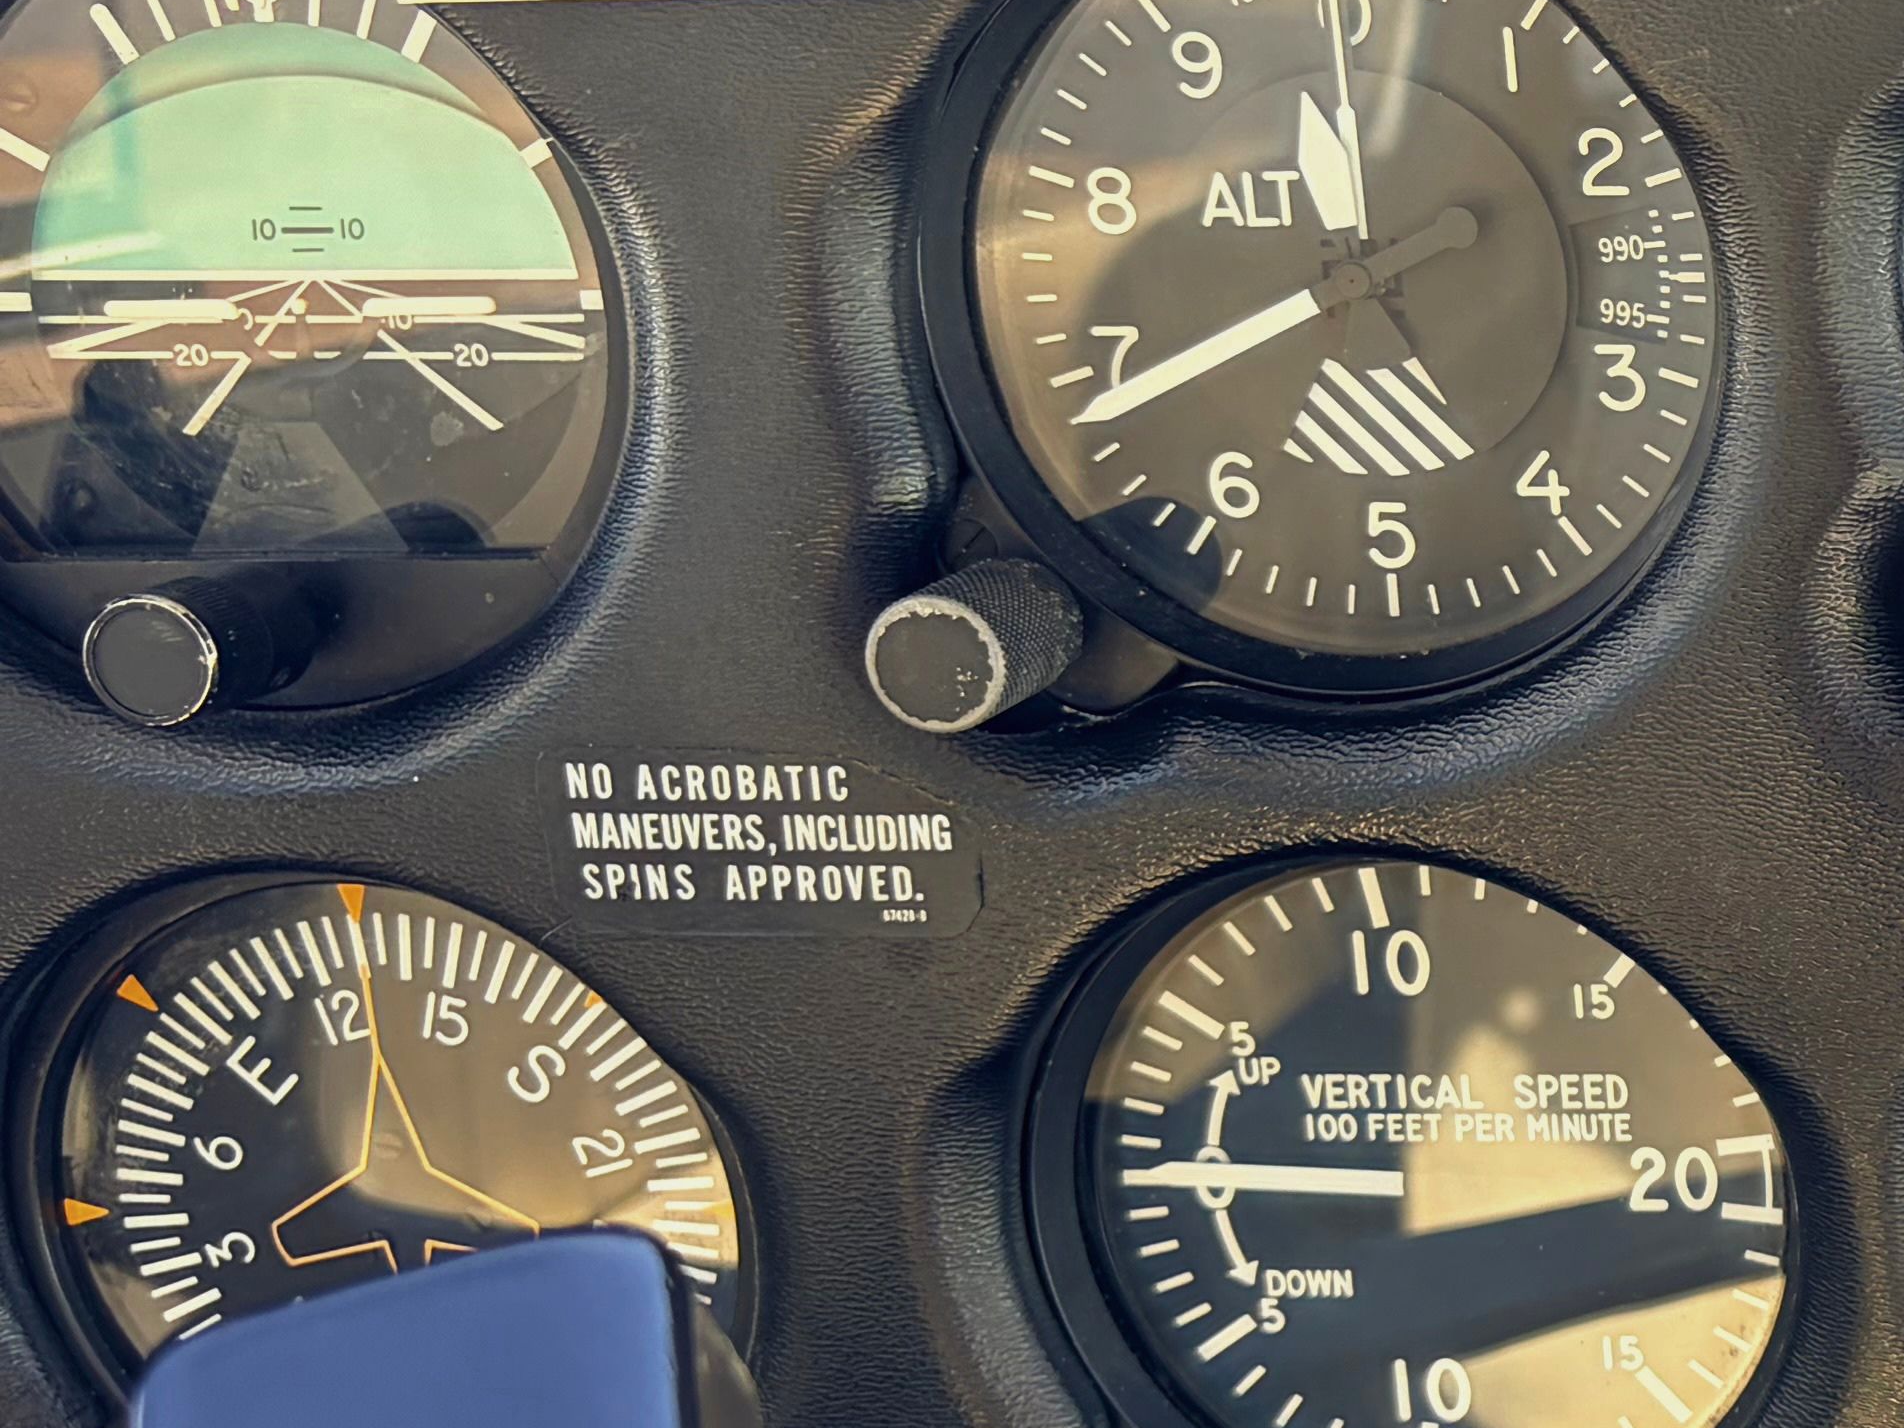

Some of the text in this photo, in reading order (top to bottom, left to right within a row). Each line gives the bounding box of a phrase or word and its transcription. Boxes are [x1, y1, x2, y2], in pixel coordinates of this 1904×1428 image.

[1202, 171, 1300, 228] ALT
[1599, 235, 1644, 262] 990
[1599, 300, 1646, 327] 995
[565, 762, 849, 802] NO ACROBATIC
[783, 814, 953, 852] INCLUDING
[582, 863, 925, 902] SPINS APPROVED.
[1301, 1073, 1629, 1110] VERTICAL SPEED
[1628, 1146, 1720, 1212] 20
[1265, 1268, 1353, 1299] DOWN
